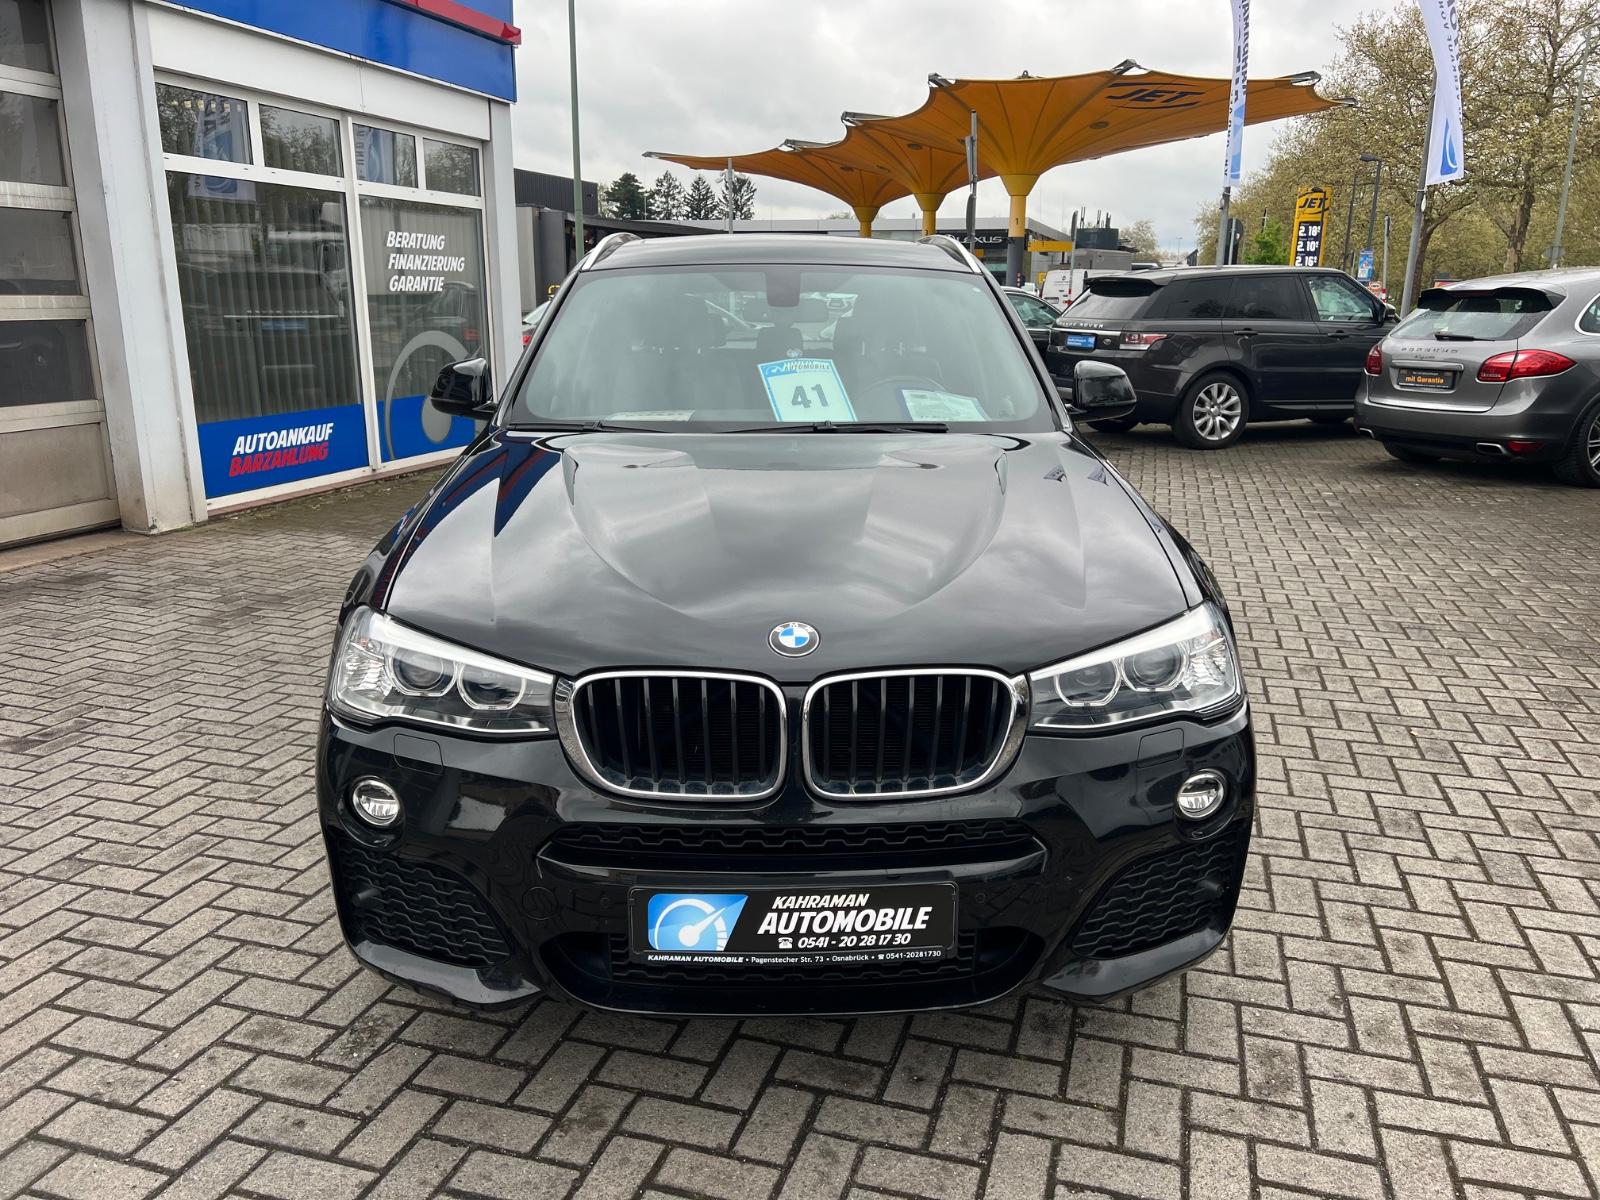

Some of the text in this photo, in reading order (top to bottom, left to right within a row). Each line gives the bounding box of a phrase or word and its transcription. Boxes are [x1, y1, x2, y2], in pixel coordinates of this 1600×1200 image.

[1104, 88, 1206, 103] JET
[1298, 198, 1328, 208] JET
[386, 231, 445, 250] BERATUNG
[388, 253, 465, 272] FINANZIERUNG
[389, 275, 445, 292] GARANTIE
[791, 384, 829, 408] 41
[232, 422, 335, 456] AUTOANKAUF
[229, 442, 329, 477] BARZAHLUNG
[772, 893, 870, 910] KAHRAMAN
[757, 906, 933, 935] AUTOMOBILE
[798, 936, 829, 949] 0541
[838, 936, 858, 947] 20
[859, 934, 877, 946] 28
[878, 934, 893, 946] 17
[892, 933, 911, 945] 30
[647, 954, 692, 962] KAHRAMAN
[693, 955, 744, 963] AUTOMOBILE
[751, 956, 799, 965] Pagenstecher
[831, 954, 869, 962] Osnabrück
[885, 950, 942, 960] 0541-20281730
